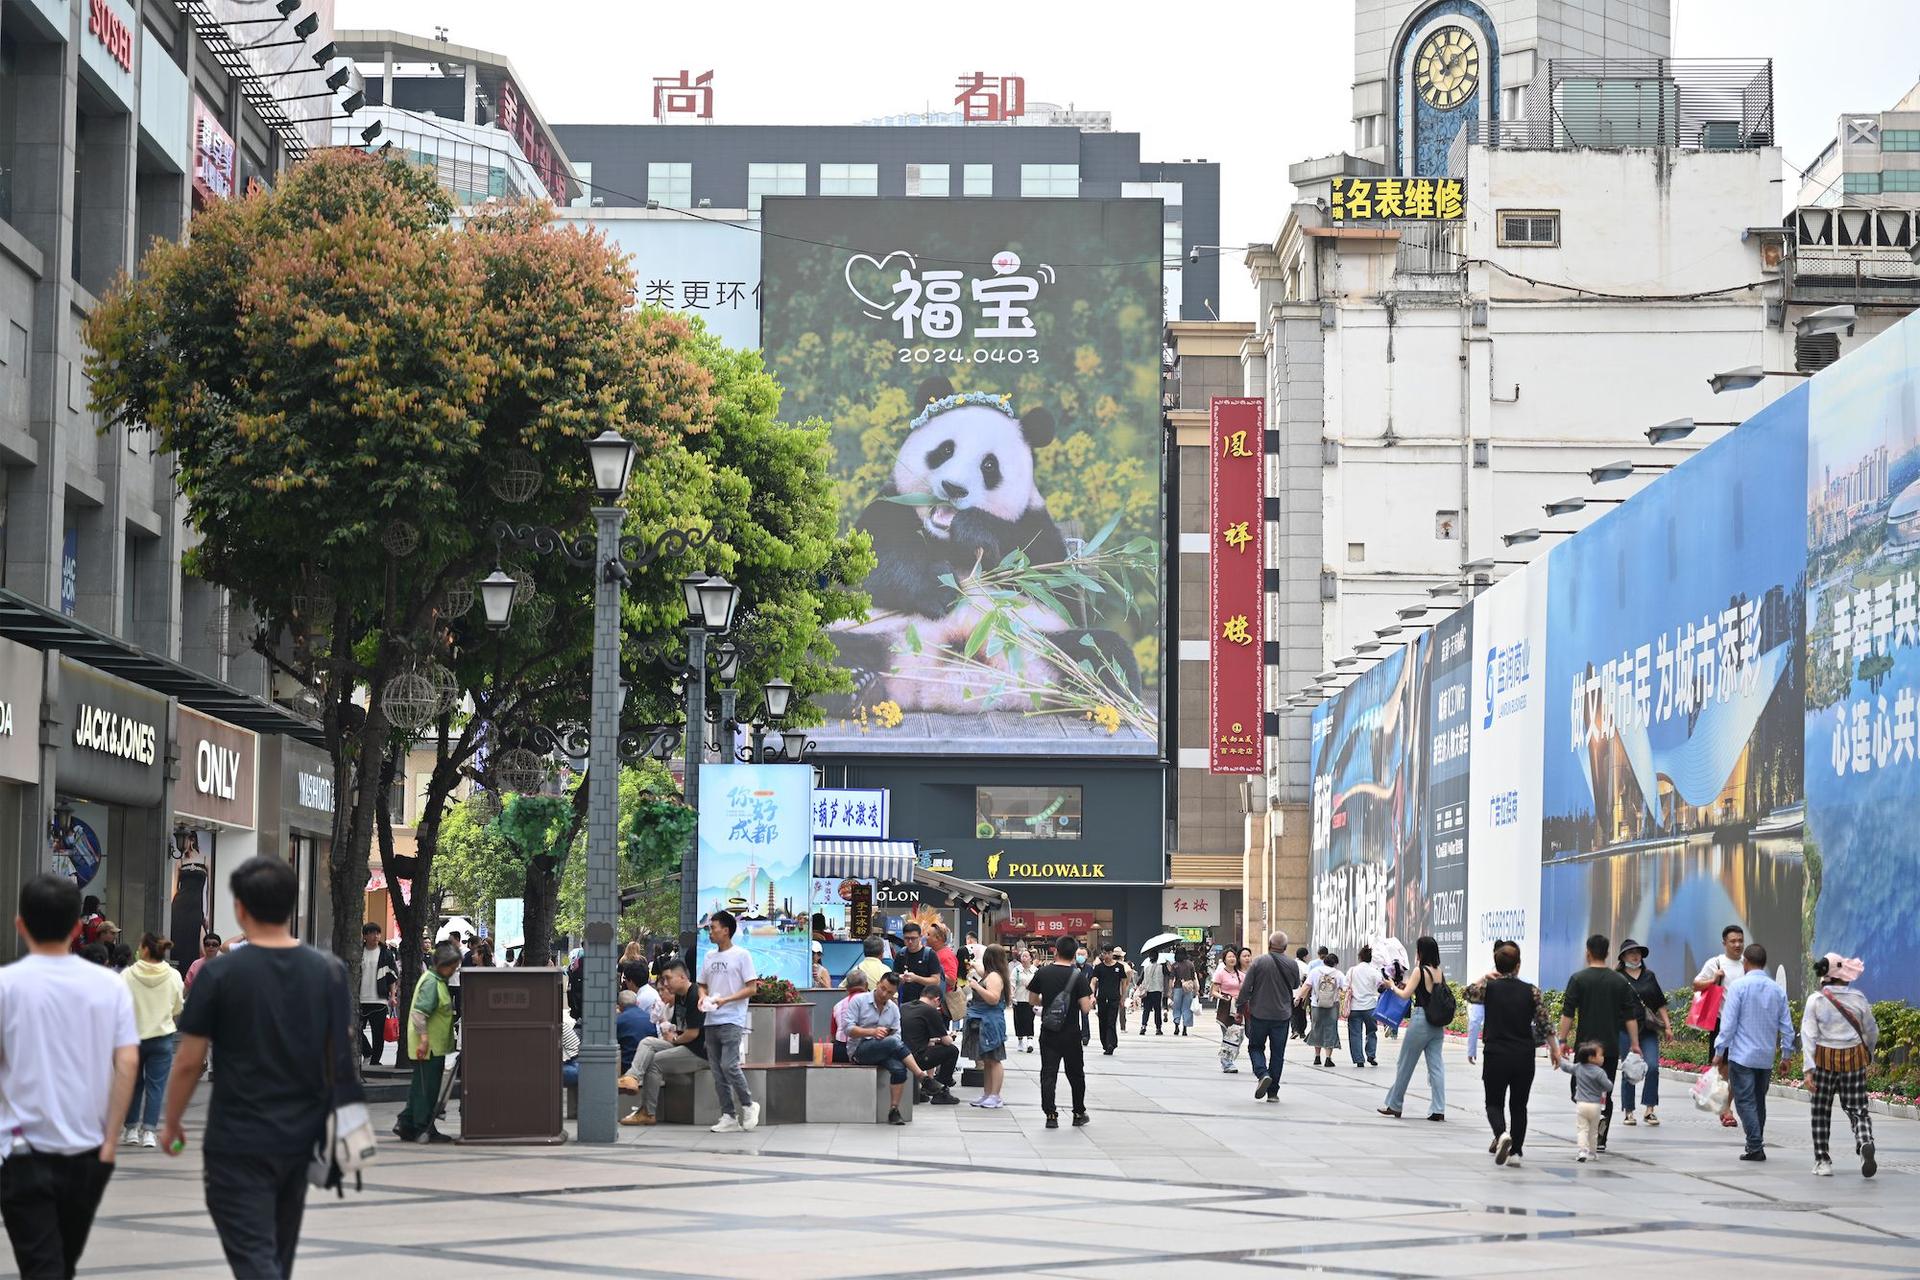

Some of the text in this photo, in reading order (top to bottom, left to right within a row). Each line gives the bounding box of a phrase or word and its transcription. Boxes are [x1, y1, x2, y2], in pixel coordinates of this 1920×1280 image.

[89, 0, 133, 73] SUSHI
[653, 70, 1024, 121] 尚 都
[1346, 178, 1463, 219] 名表维修
[624, 279, 761, 310] 类更环
[892, 266, 1039, 339] 福宝
[898, 348, 1040, 364] 2024.0403
[1832, 571, 1920, 669] 手牵手共
[1831, 687, 1920, 777] 心连心共
[197, 739, 241, 800] ONLY
[726, 786, 778, 822] 你好
[728, 818, 779, 844] 成都
[1008, 863, 1105, 878] POLOWALK
[1173, 897, 1209, 912] 红妆
